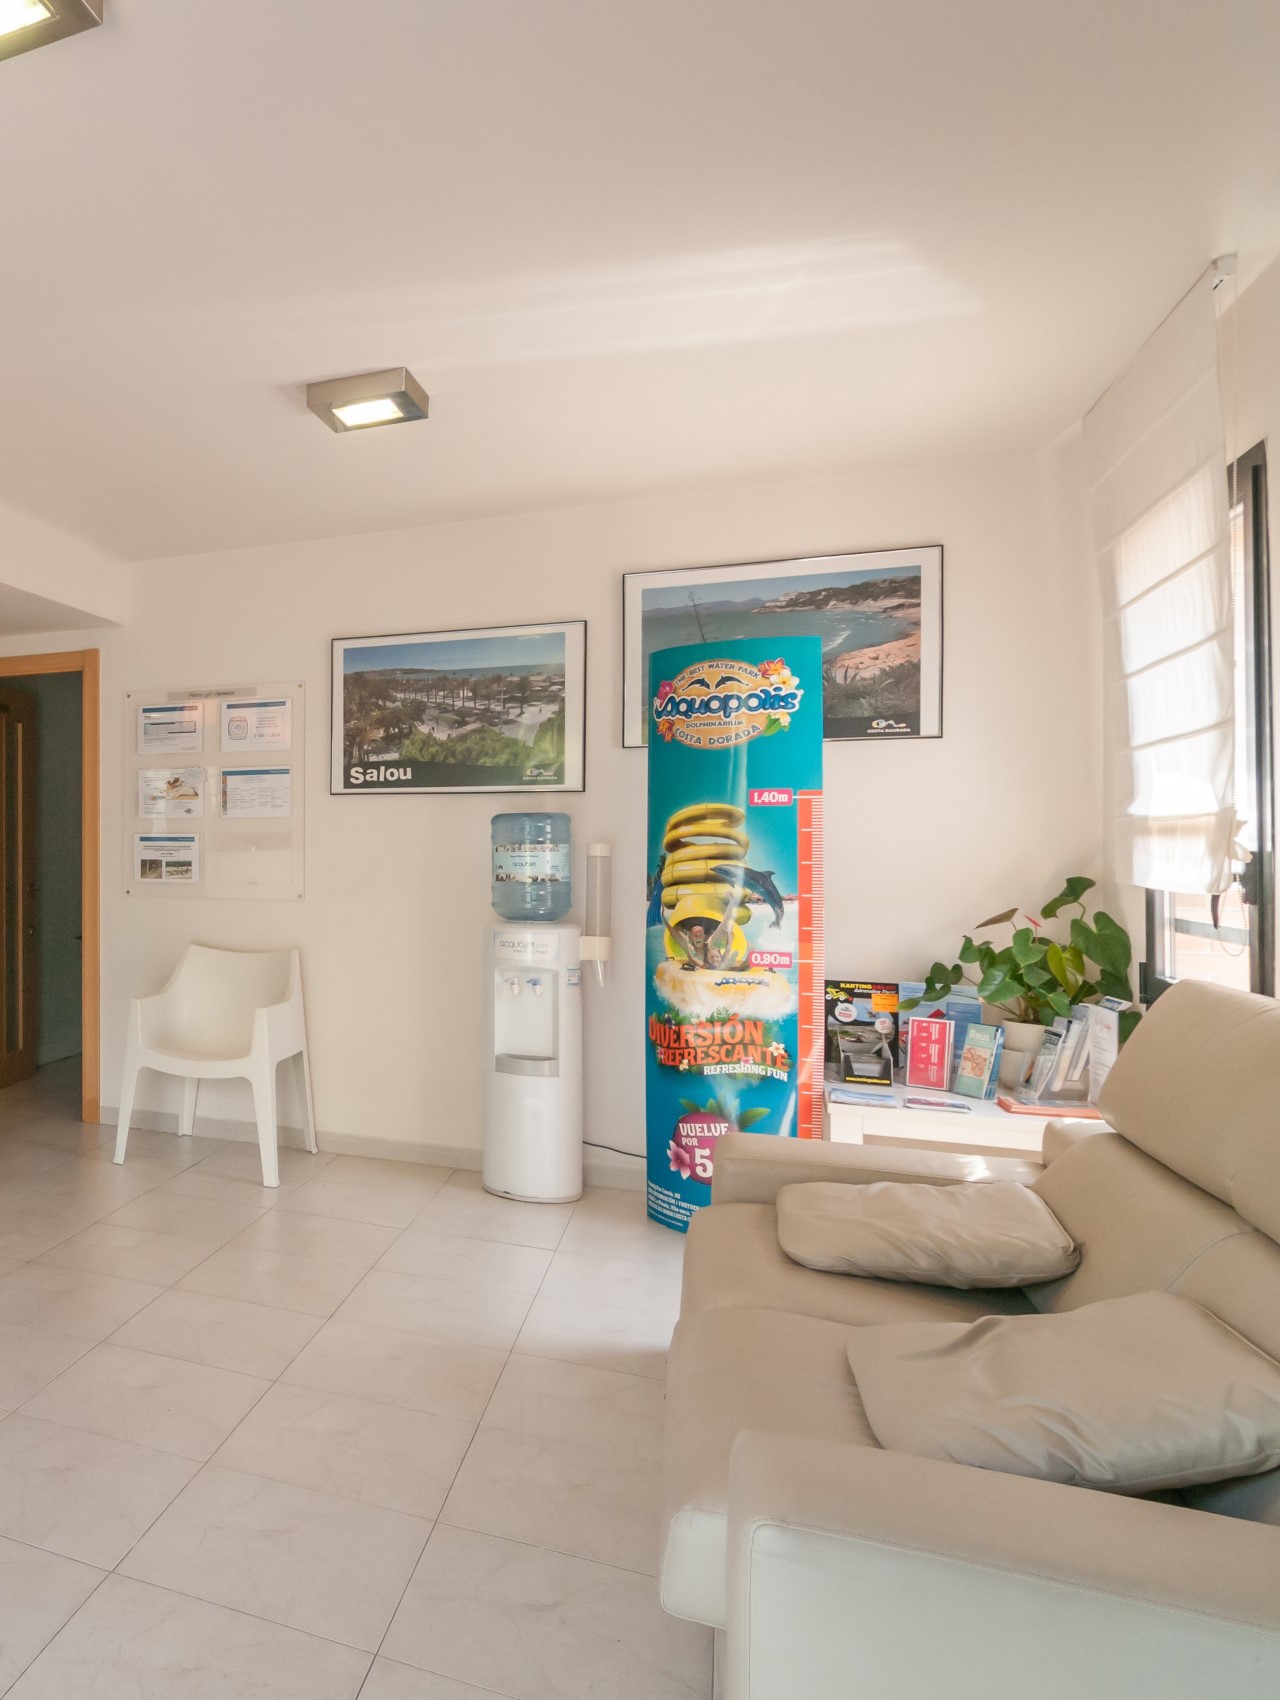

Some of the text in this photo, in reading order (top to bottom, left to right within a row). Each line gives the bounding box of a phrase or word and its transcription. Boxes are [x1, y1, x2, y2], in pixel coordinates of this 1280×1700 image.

[676, 662, 761, 687] THE BEST WATER PARK
[673, 723, 761, 746] COSTA DORADA
[349, 765, 412, 785] Salou
[753, 791, 789, 803] 1,40m
[751, 952, 791, 966] 0,90m
[648, 1012, 764, 1048] DIVERSIÓN
[662, 1044, 789, 1071] REFRESCANTE
[703, 1062, 788, 1082] REFRESHING FUN
[681, 1137, 698, 1146] POR
[695, 1147, 713, 1178] 5
